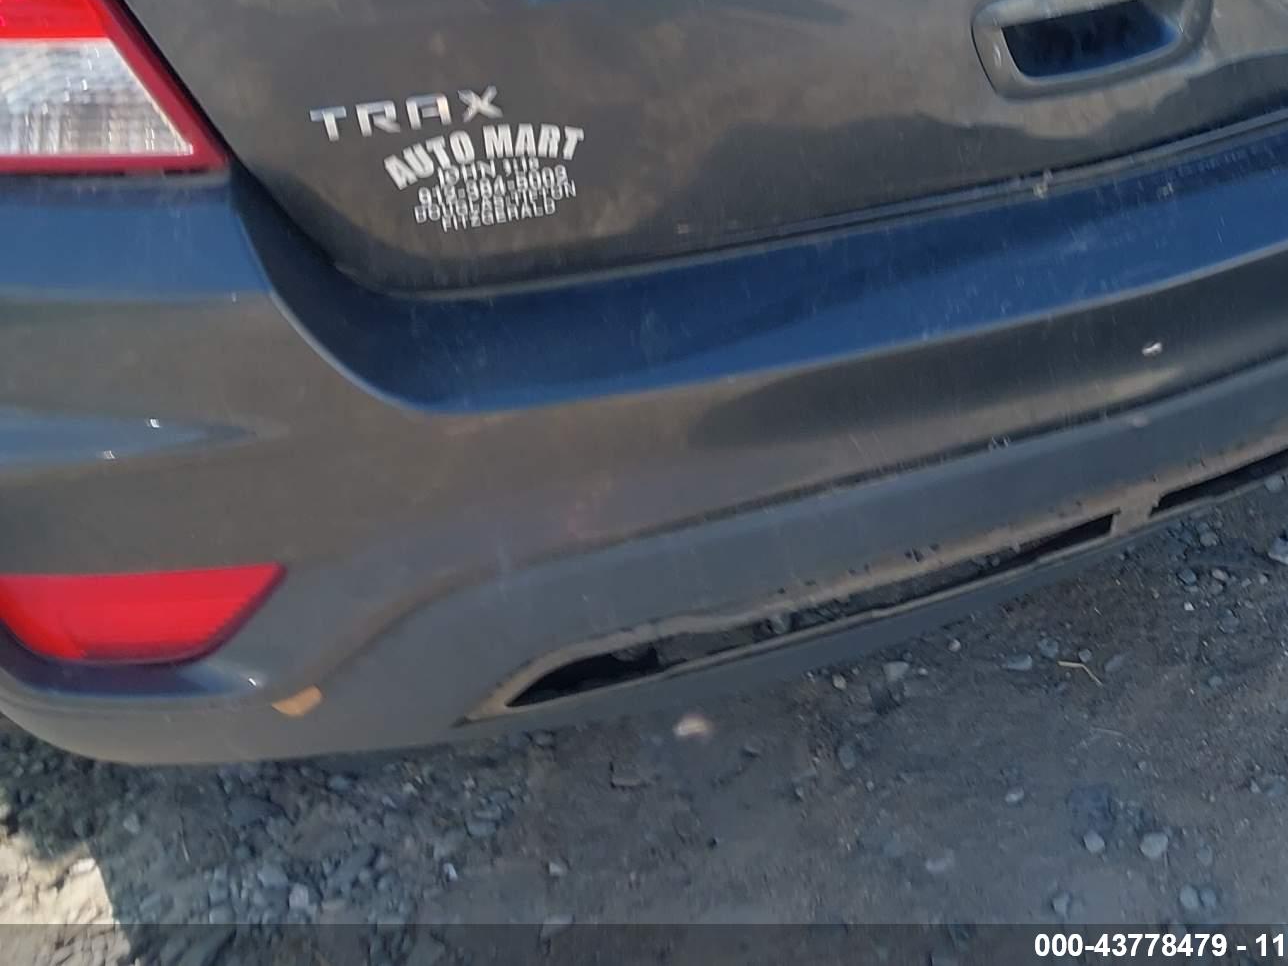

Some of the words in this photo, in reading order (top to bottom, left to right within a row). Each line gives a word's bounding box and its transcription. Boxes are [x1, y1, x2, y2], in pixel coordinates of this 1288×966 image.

[310, 85, 503, 141] TRAX
[384, 130, 475, 190] AUTO
[482, 123, 584, 160] MART
